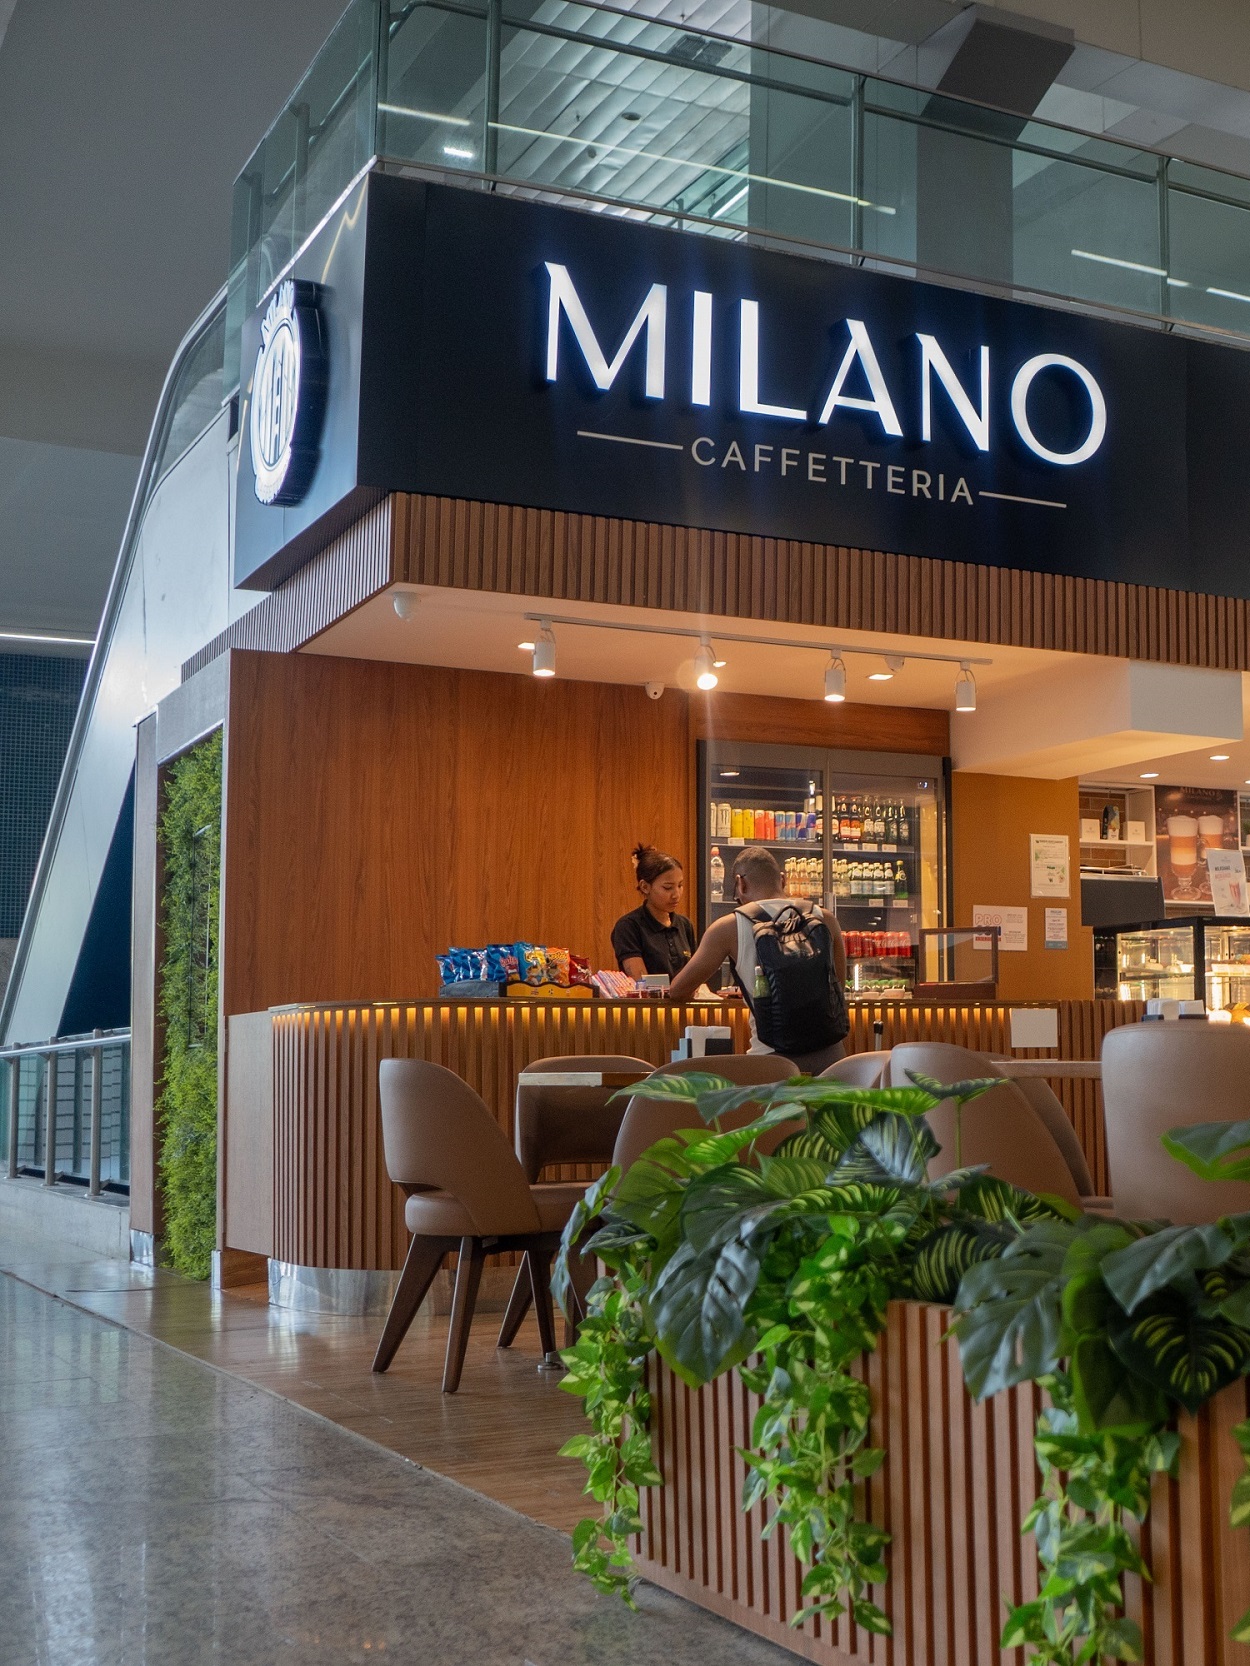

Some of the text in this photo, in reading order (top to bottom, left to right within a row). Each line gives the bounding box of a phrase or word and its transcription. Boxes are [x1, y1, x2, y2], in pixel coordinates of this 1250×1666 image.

[544, 261, 1107, 465] MILANO
[691, 437, 974, 506] CAFFETTERIA
[974, 913, 1002, 926] PRO
